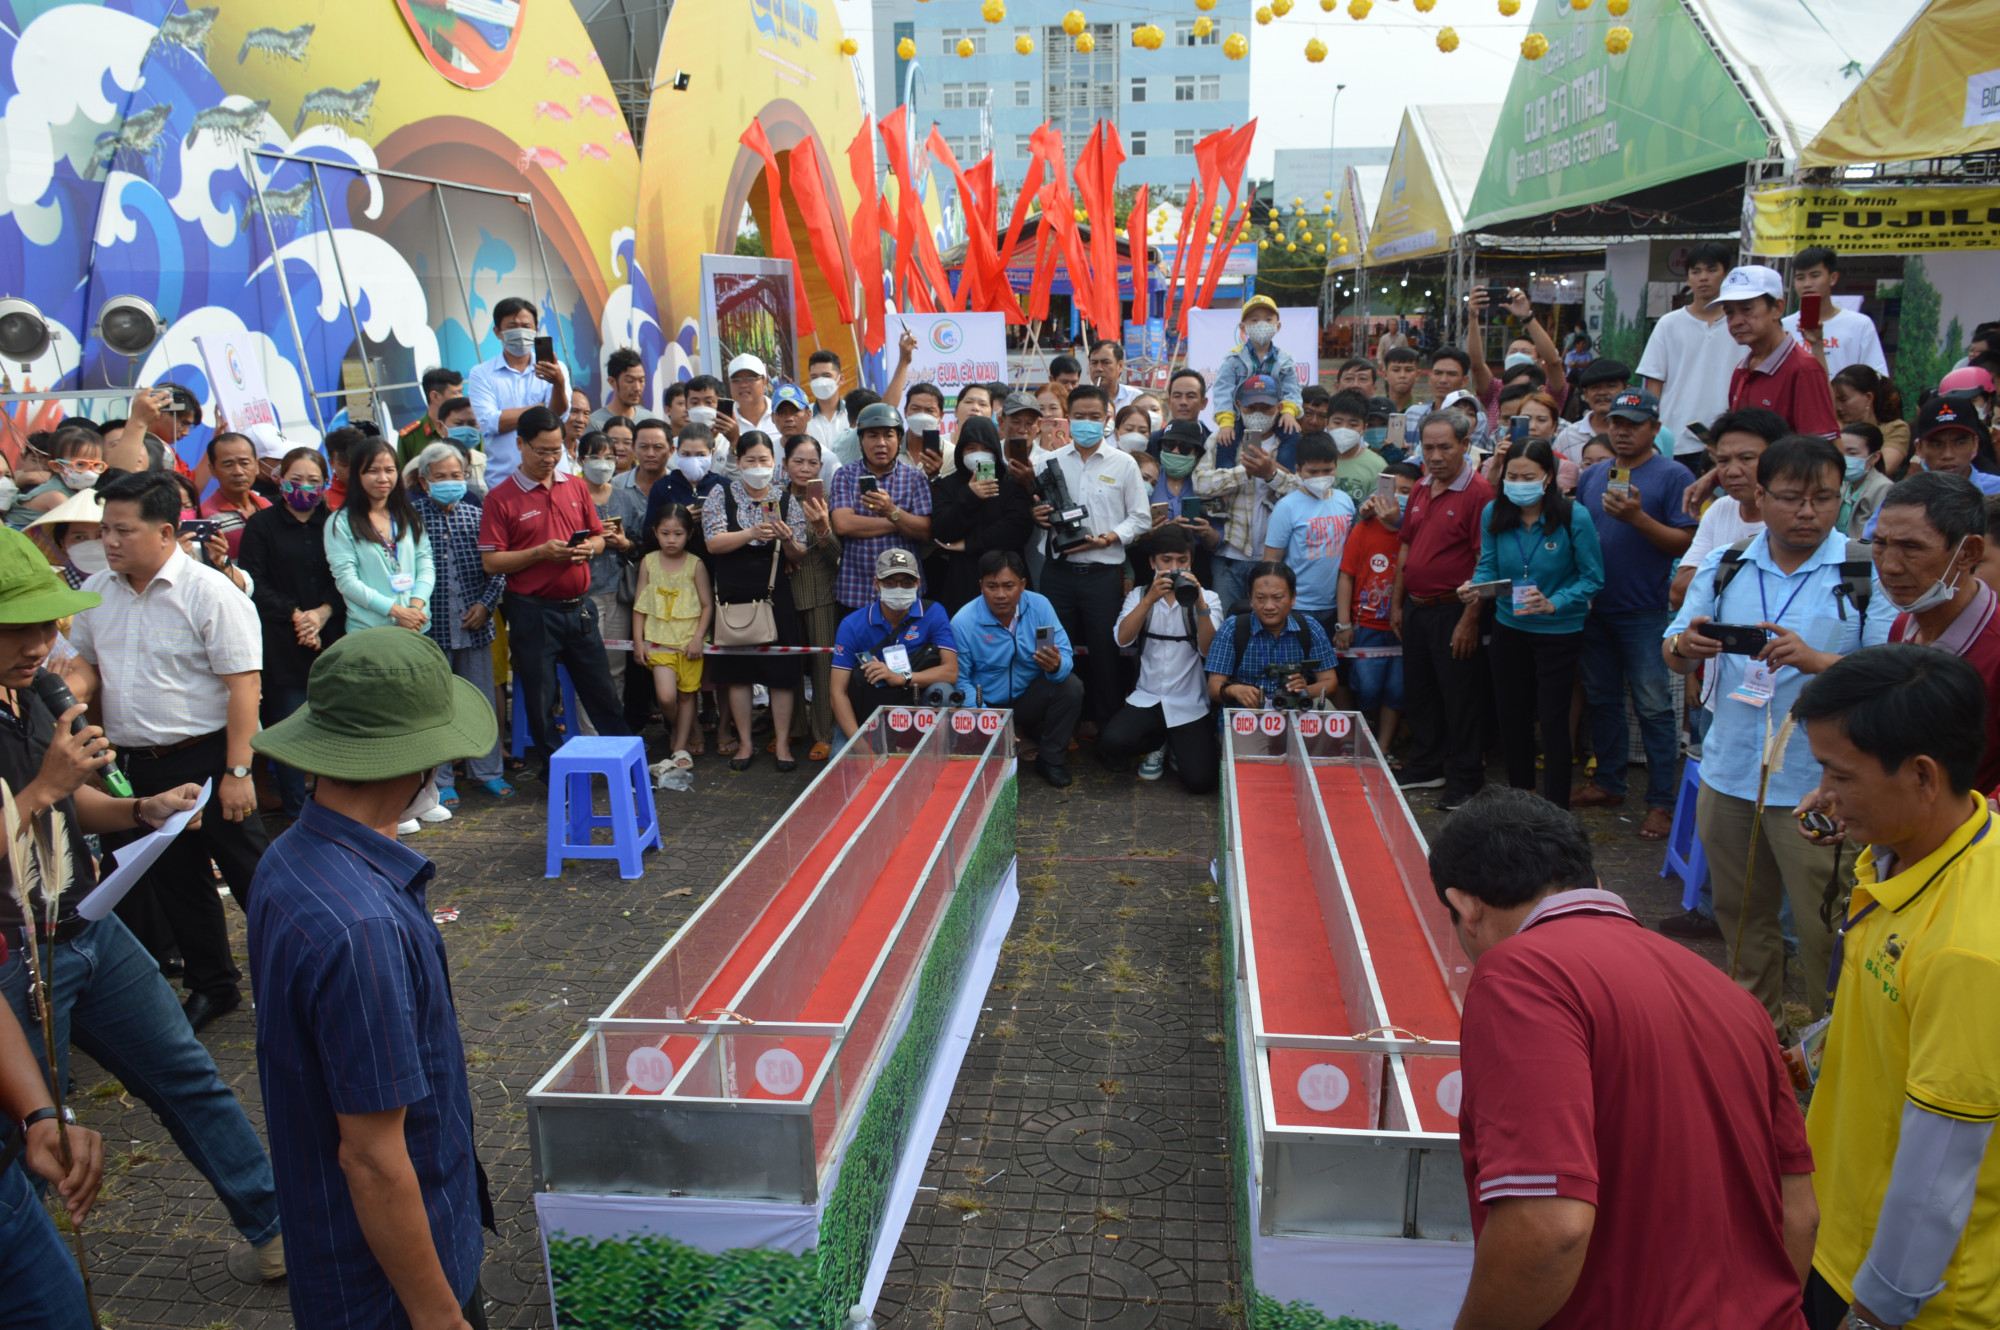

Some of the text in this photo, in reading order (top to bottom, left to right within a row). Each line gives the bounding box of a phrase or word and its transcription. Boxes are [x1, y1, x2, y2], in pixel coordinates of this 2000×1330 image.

[1572, 64, 1608, 126] MAU
[1572, 120, 1619, 164] FESTIVAL
[937, 361, 960, 386] CUA
[960, 358, 976, 386] CÀ
[976, 360, 999, 384] MAU
[1371, 558, 1388, 569] KDL
[892, 711, 933, 728] ĐÍCH 04
[955, 713, 998, 730] ĐÍCH 03
[1236, 715, 1281, 731] ĐÍCH 02
[1300, 716, 1345, 733] ĐÍCH 01
